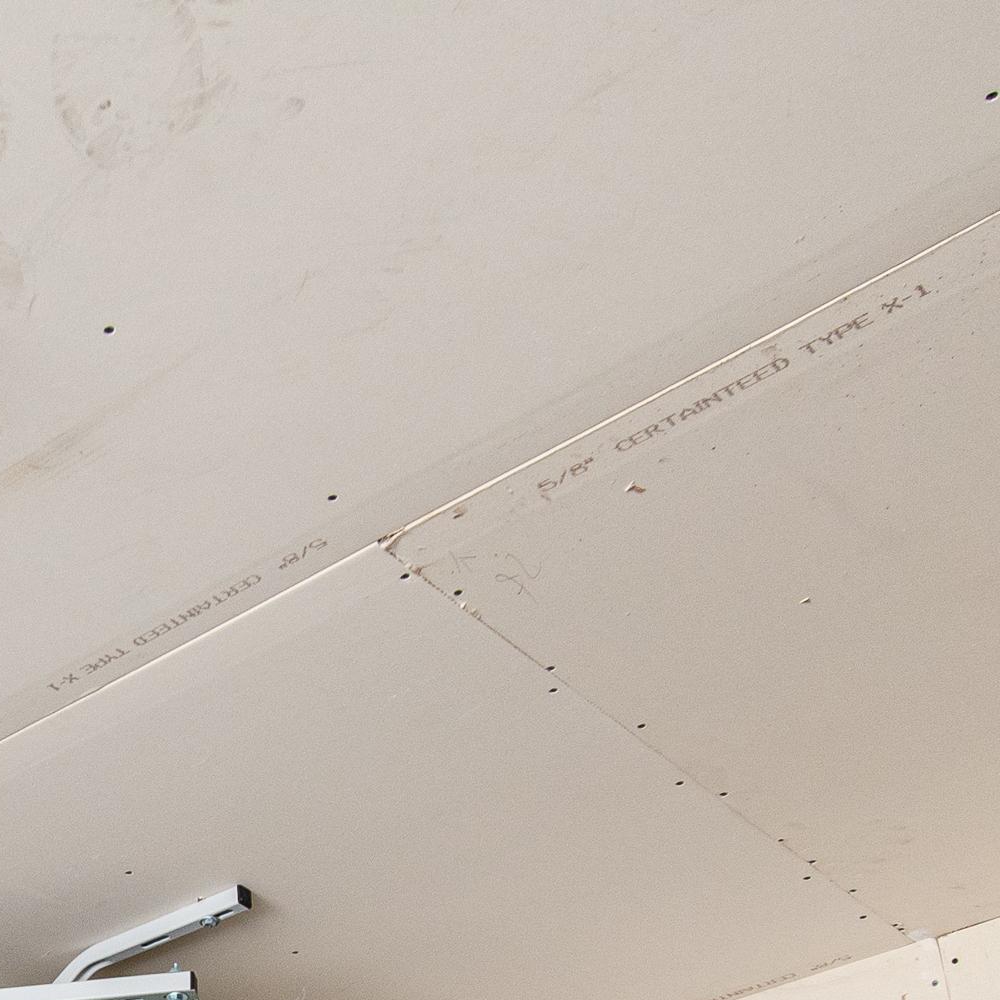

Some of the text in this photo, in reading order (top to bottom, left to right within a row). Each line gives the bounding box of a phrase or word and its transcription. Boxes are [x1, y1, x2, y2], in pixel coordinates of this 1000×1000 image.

[537, 284, 932, 492] 5/8" CERTAINTEED TYPE X-1
[133, 574, 262, 647] CERTAINTEED
[80, 647, 131, 674] TYPE
